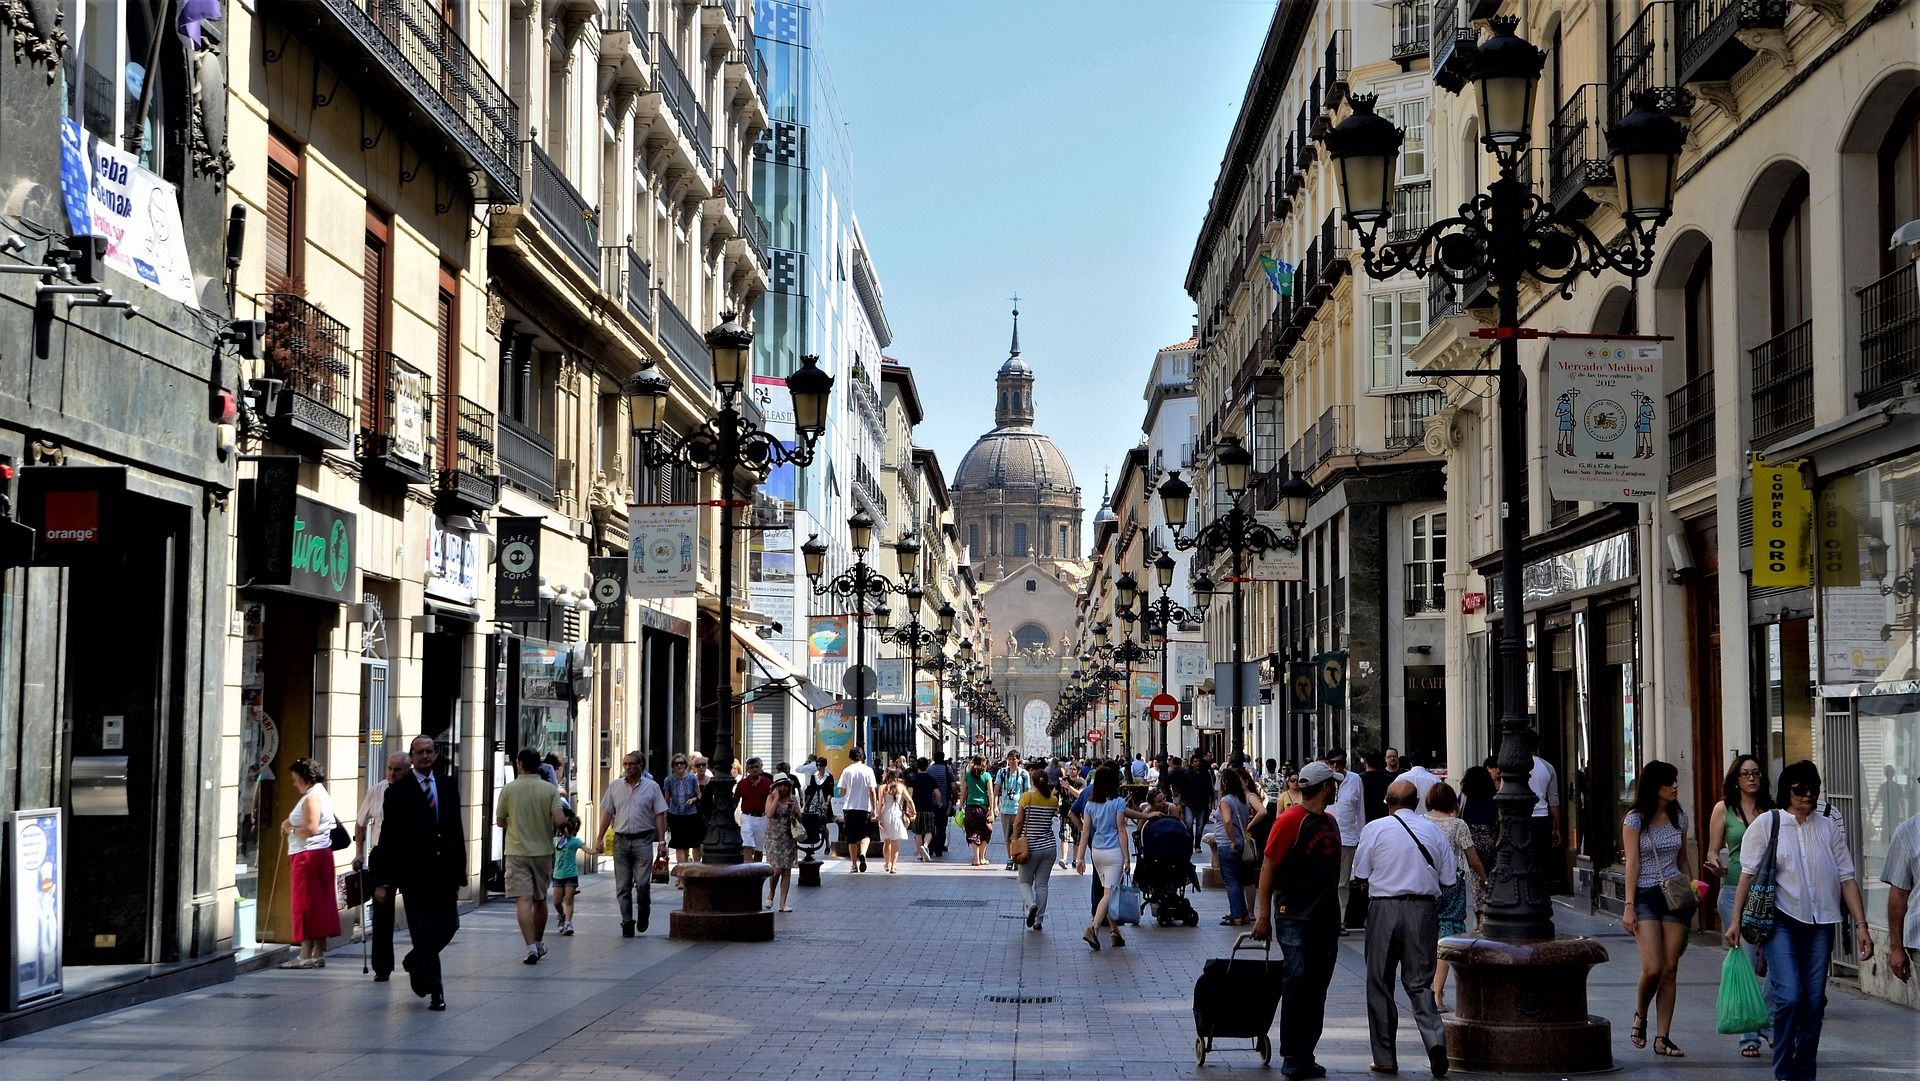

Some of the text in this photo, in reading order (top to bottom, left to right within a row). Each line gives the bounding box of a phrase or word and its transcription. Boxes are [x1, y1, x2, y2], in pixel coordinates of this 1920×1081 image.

[1558, 361, 1654, 373] Mercado Medieval
[1772, 474, 1784, 528] COMPRO
[47, 530, 93, 541] orange
[1769, 539, 1786, 572] ORO
[502, 571, 533, 580] COPAS
[1409, 677, 1446, 689] IL CAFF
